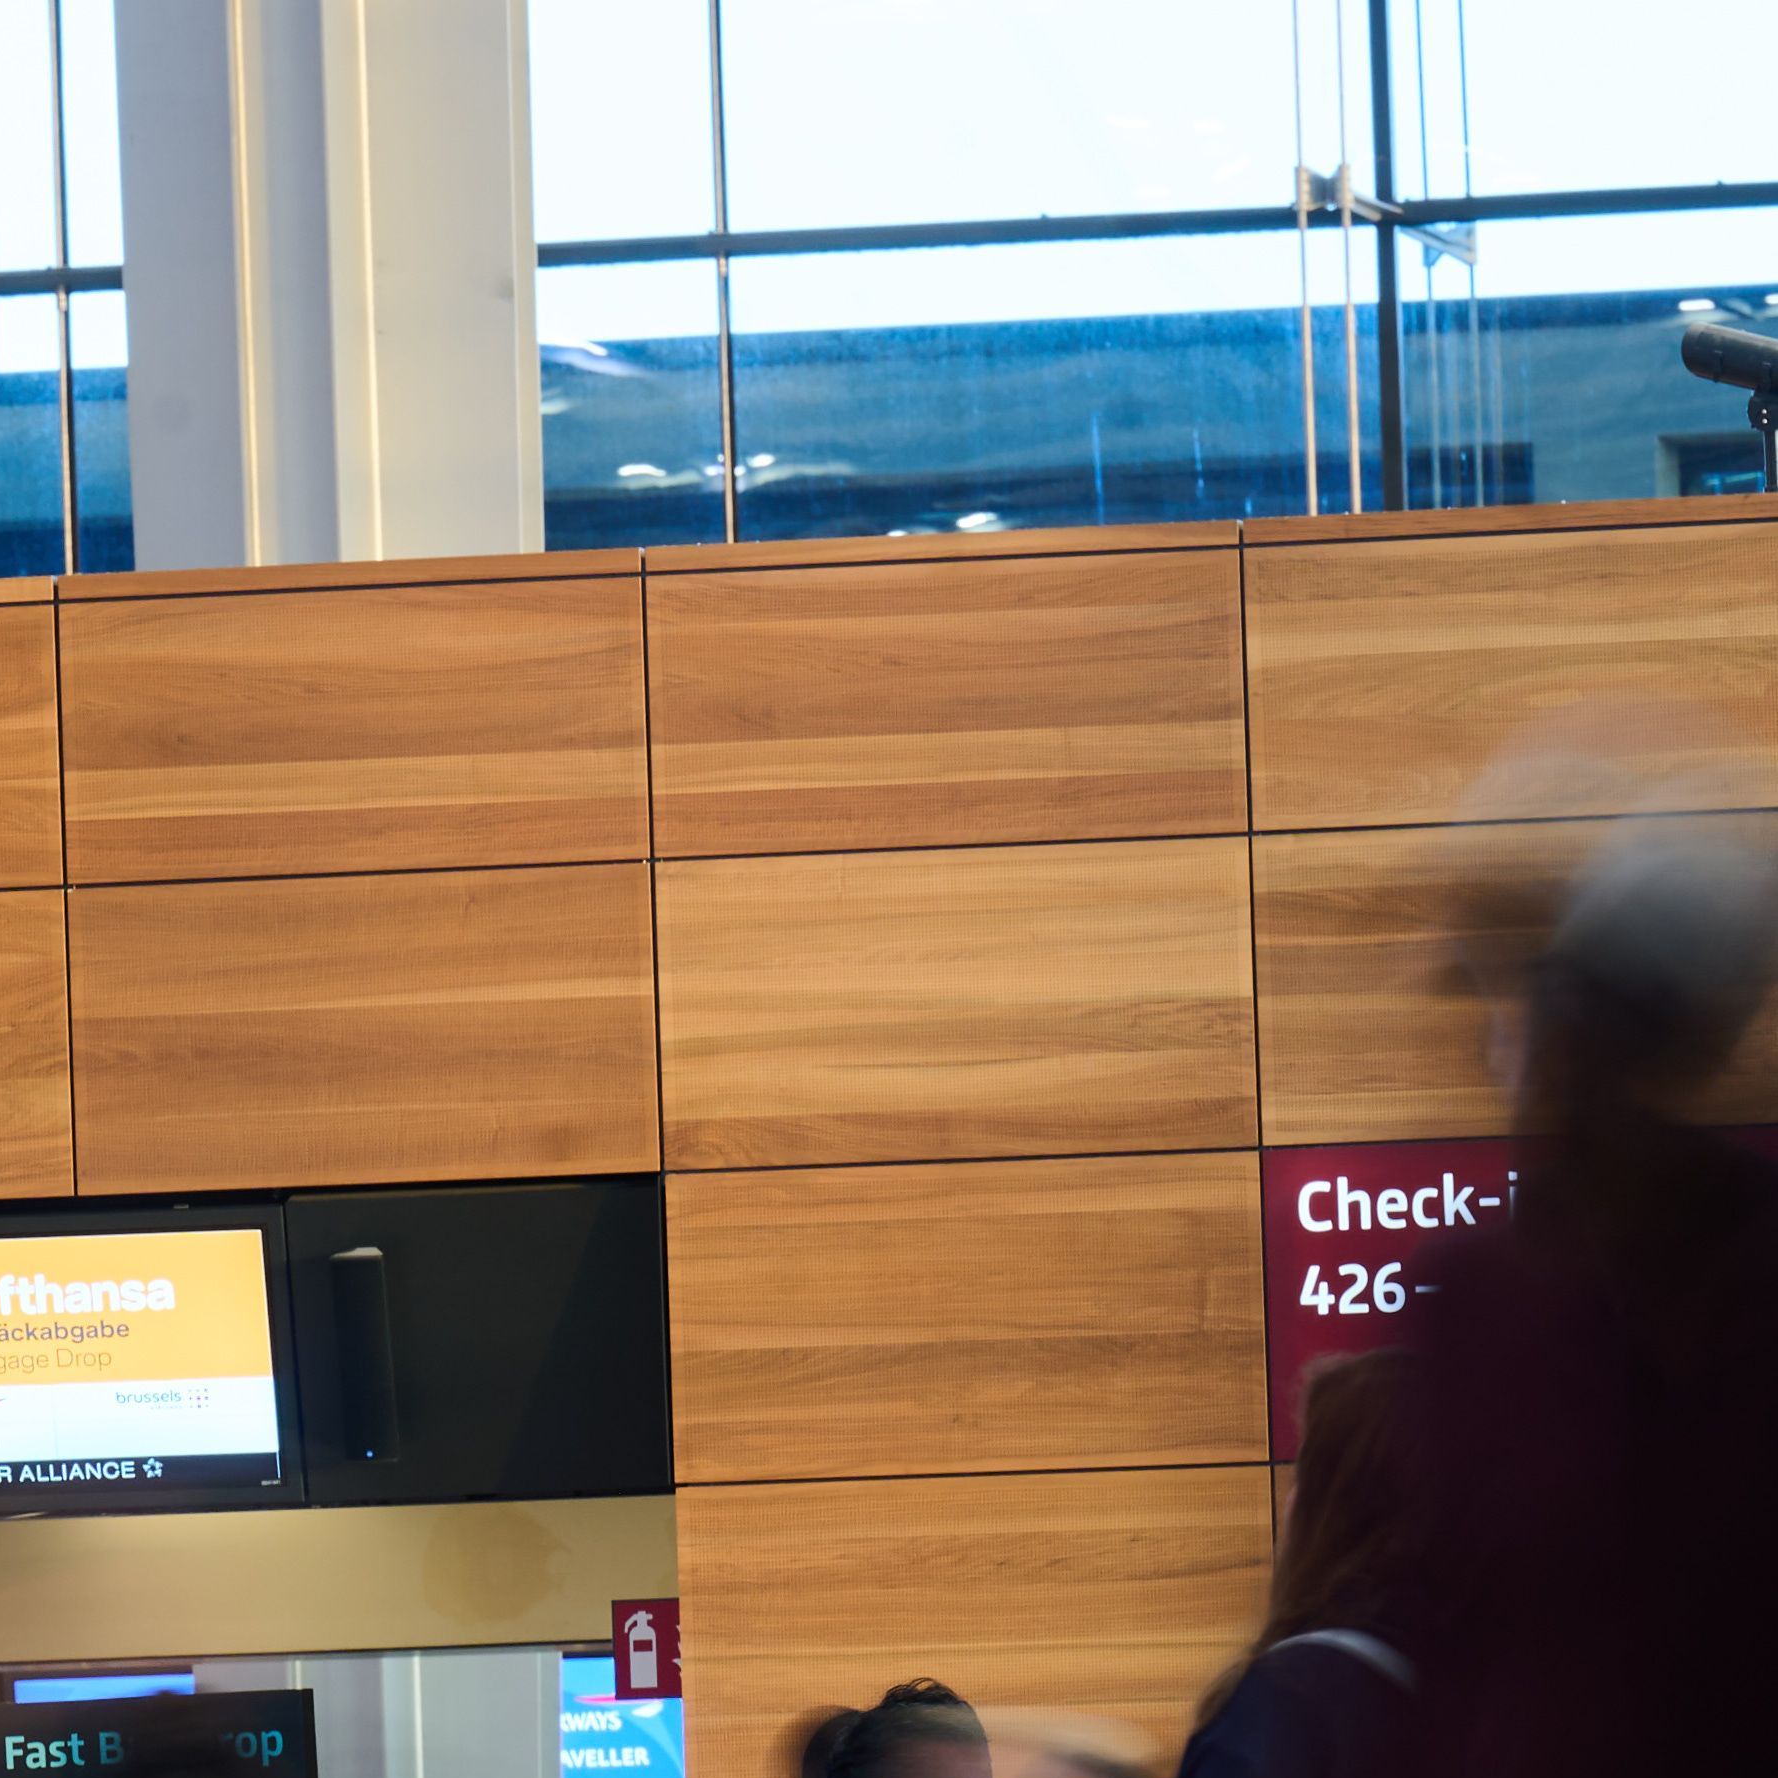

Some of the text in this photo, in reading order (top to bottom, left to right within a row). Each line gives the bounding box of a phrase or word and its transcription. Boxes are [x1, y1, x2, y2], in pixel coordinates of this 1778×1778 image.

[1296, 1169, 1520, 1233] Check-i
[54, 1344, 114, 1373] Drop
[113, 1387, 184, 1410] brussels
[17, 1457, 138, 1484] ALLIANCE
[5, 1732, 86, 1771] Fast
[560, 1747, 649, 1768] AVELLER
